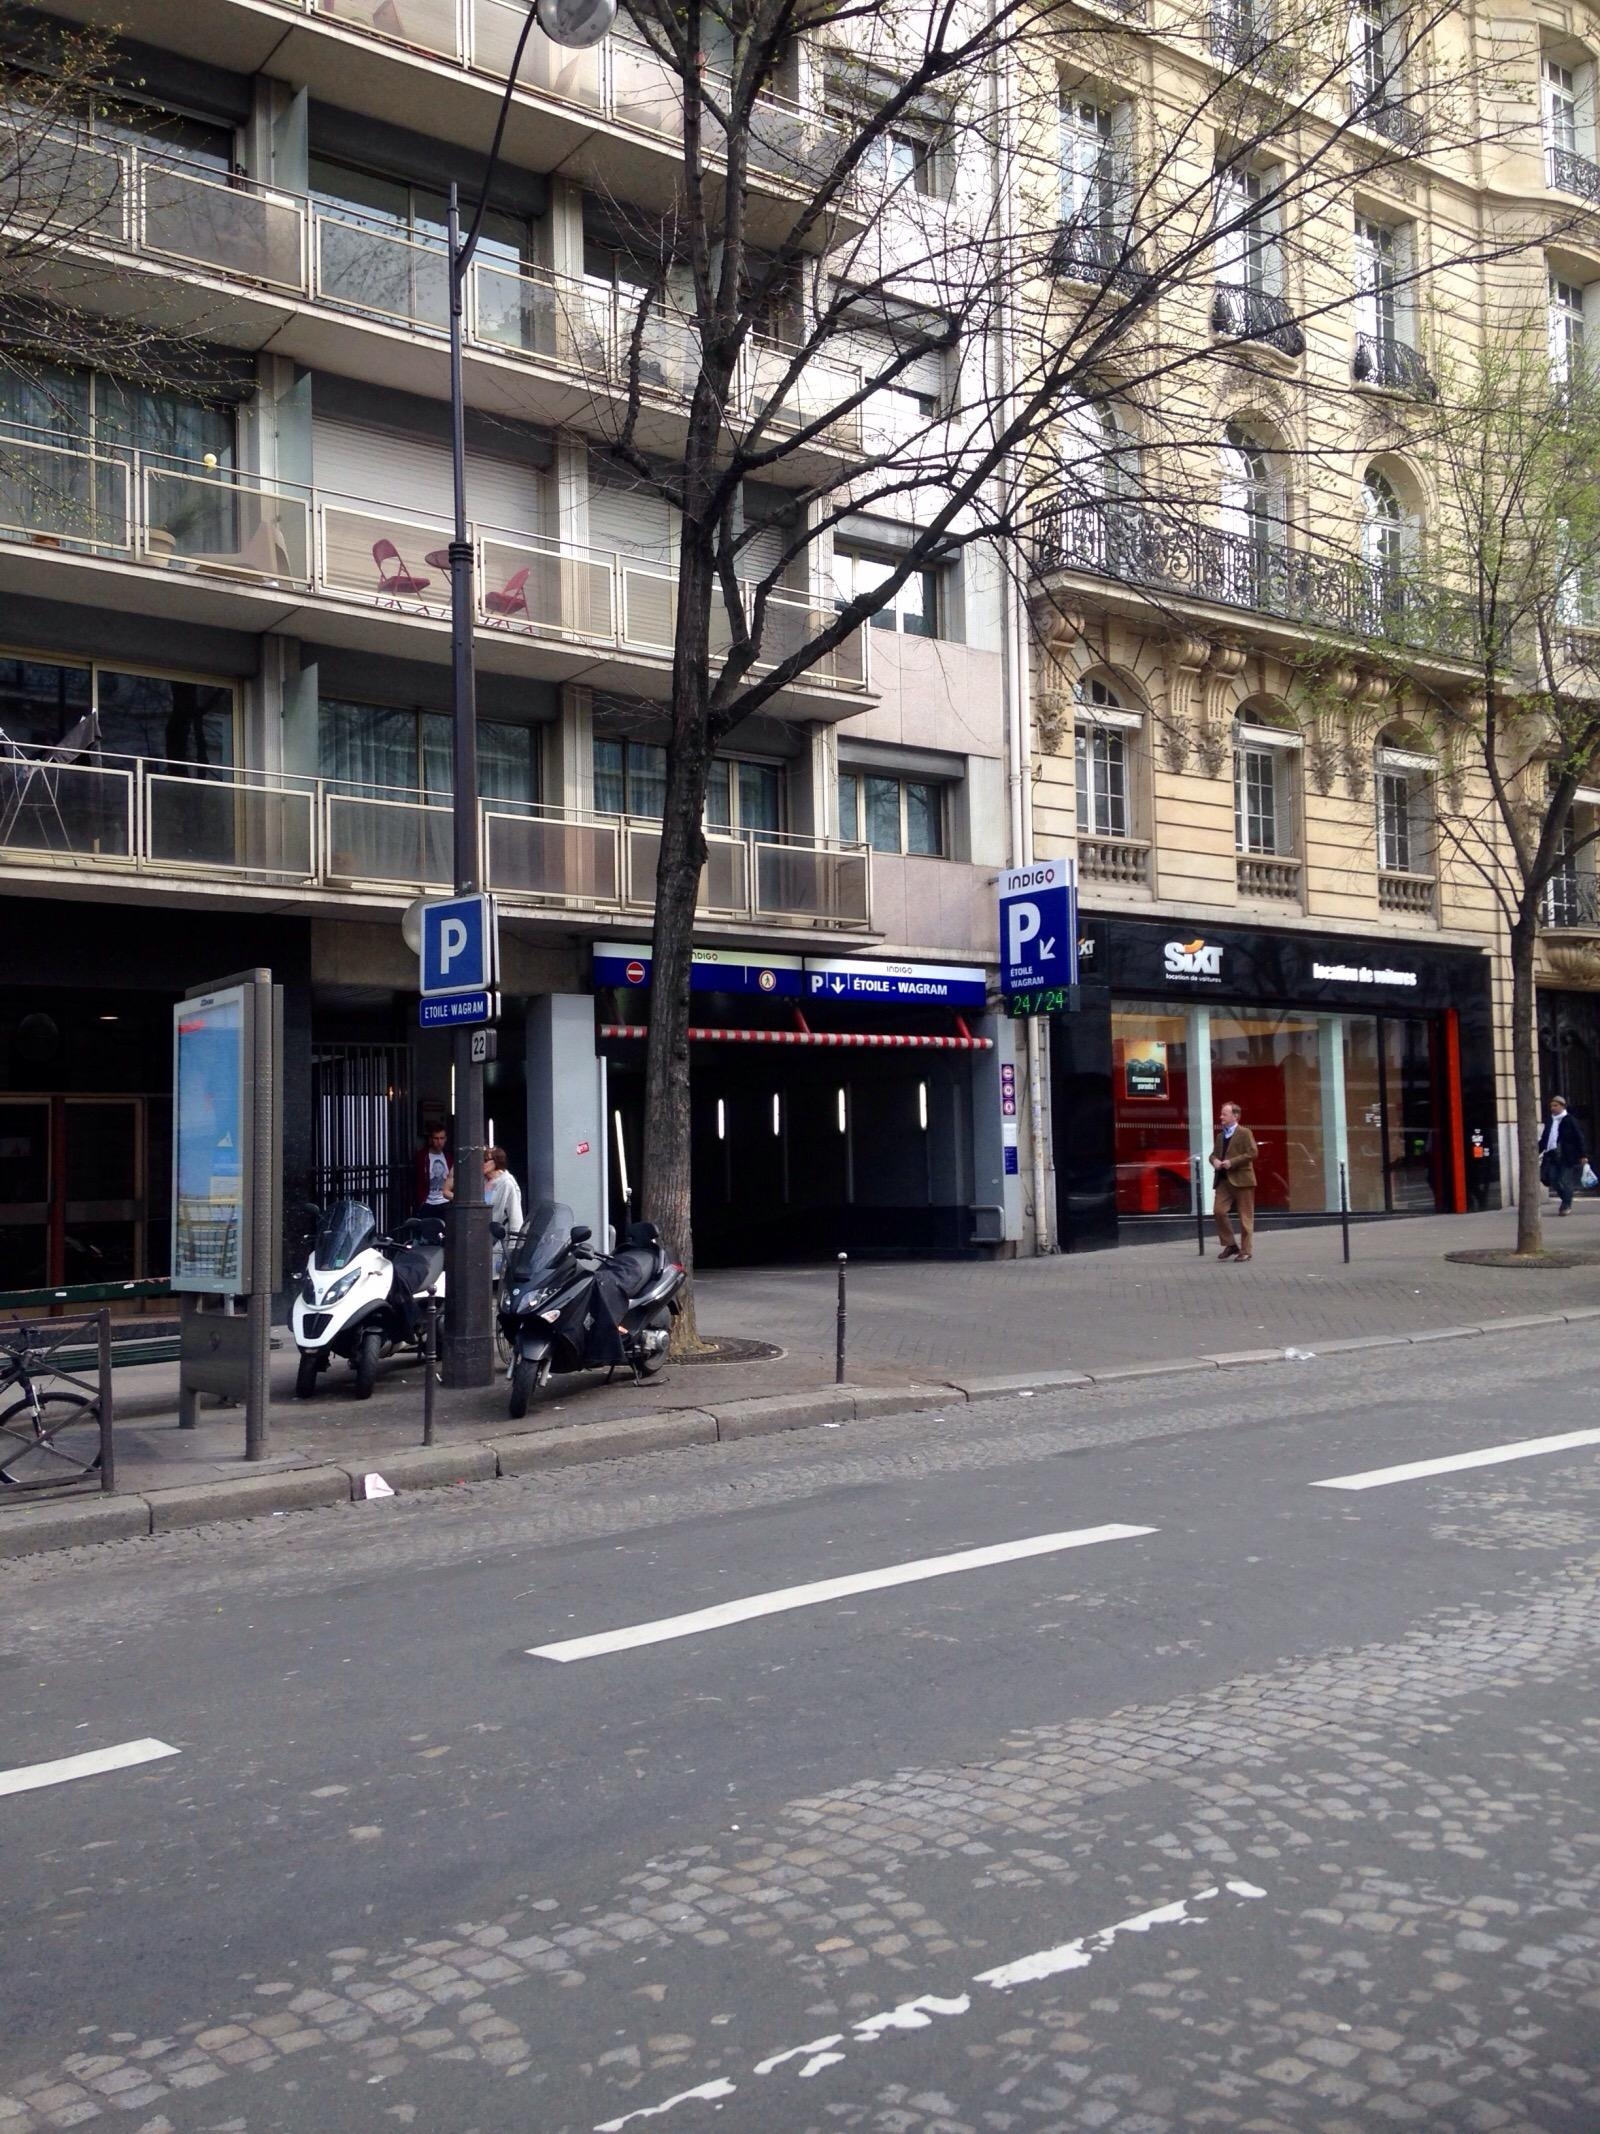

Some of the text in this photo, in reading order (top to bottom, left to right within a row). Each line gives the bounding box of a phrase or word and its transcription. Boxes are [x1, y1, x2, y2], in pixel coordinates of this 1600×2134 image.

[1008, 868, 1055, 890] INDIGO
[1008, 902, 1041, 966] P
[440, 918, 468, 975] P
[691, 951, 719, 961] NDIGO
[886, 966, 913, 974] INDIGO
[1010, 965, 1033, 977] ÉTOILE
[1313, 962, 1359, 981] location
[1359, 967, 1373, 983] de
[811, 975, 824, 993] P
[853, 977, 890, 992] ÉTOILE
[898, 981, 948, 996] WAGRAM
[1010, 976, 1044, 989] WAGRAM
[1013, 995, 1031, 1015] 24
[1045, 990, 1065, 1011] 24
[473, 1036, 485, 1055] 22
